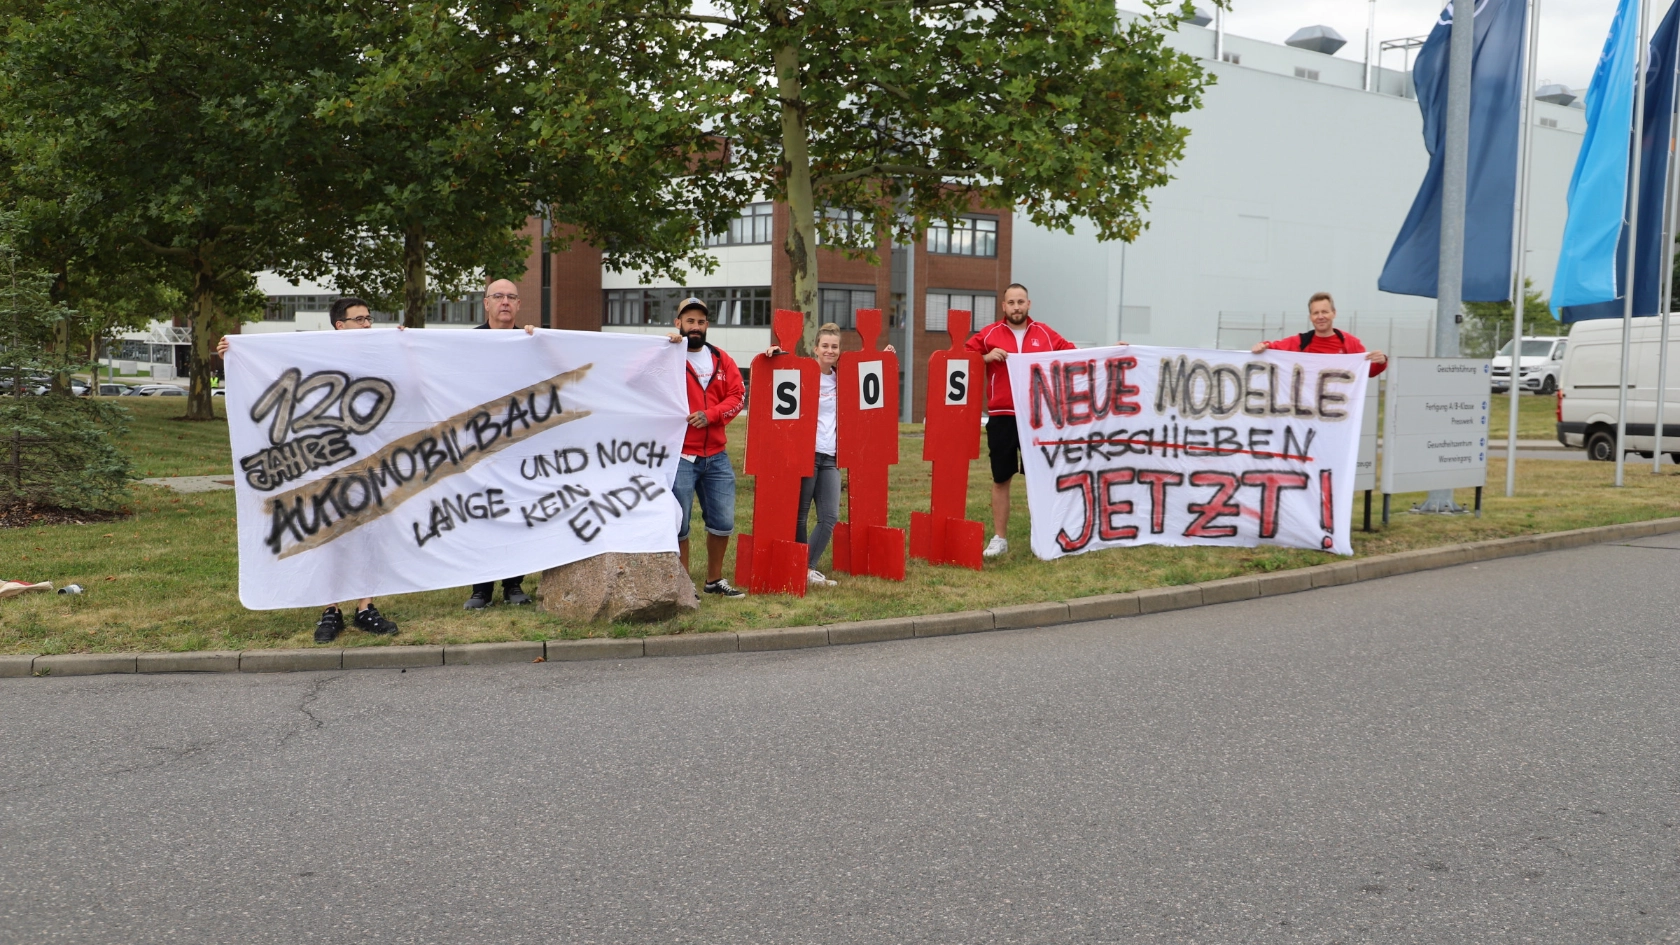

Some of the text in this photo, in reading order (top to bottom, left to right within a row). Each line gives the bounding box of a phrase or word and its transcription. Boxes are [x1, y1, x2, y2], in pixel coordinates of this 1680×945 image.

[947, 370, 966, 401] S
[1436, 364, 1477, 375] Geschäftsführung
[250, 367, 396, 446] 120
[775, 381, 798, 416] S
[1028, 354, 1356, 430] NEUE MODELLE
[1425, 402, 1448, 413] Fertigung
[1451, 416, 1474, 425] Presswerk
[240, 428, 357, 492] JAHRE
[520, 439, 670, 481] UND NOCH
[1427, 439, 1473, 449] Gesundheitszentrum
[1438, 455, 1472, 464] Wareneingang
[412, 484, 590, 547] LANGE KEIN
[568, 474, 666, 543] ENDE
